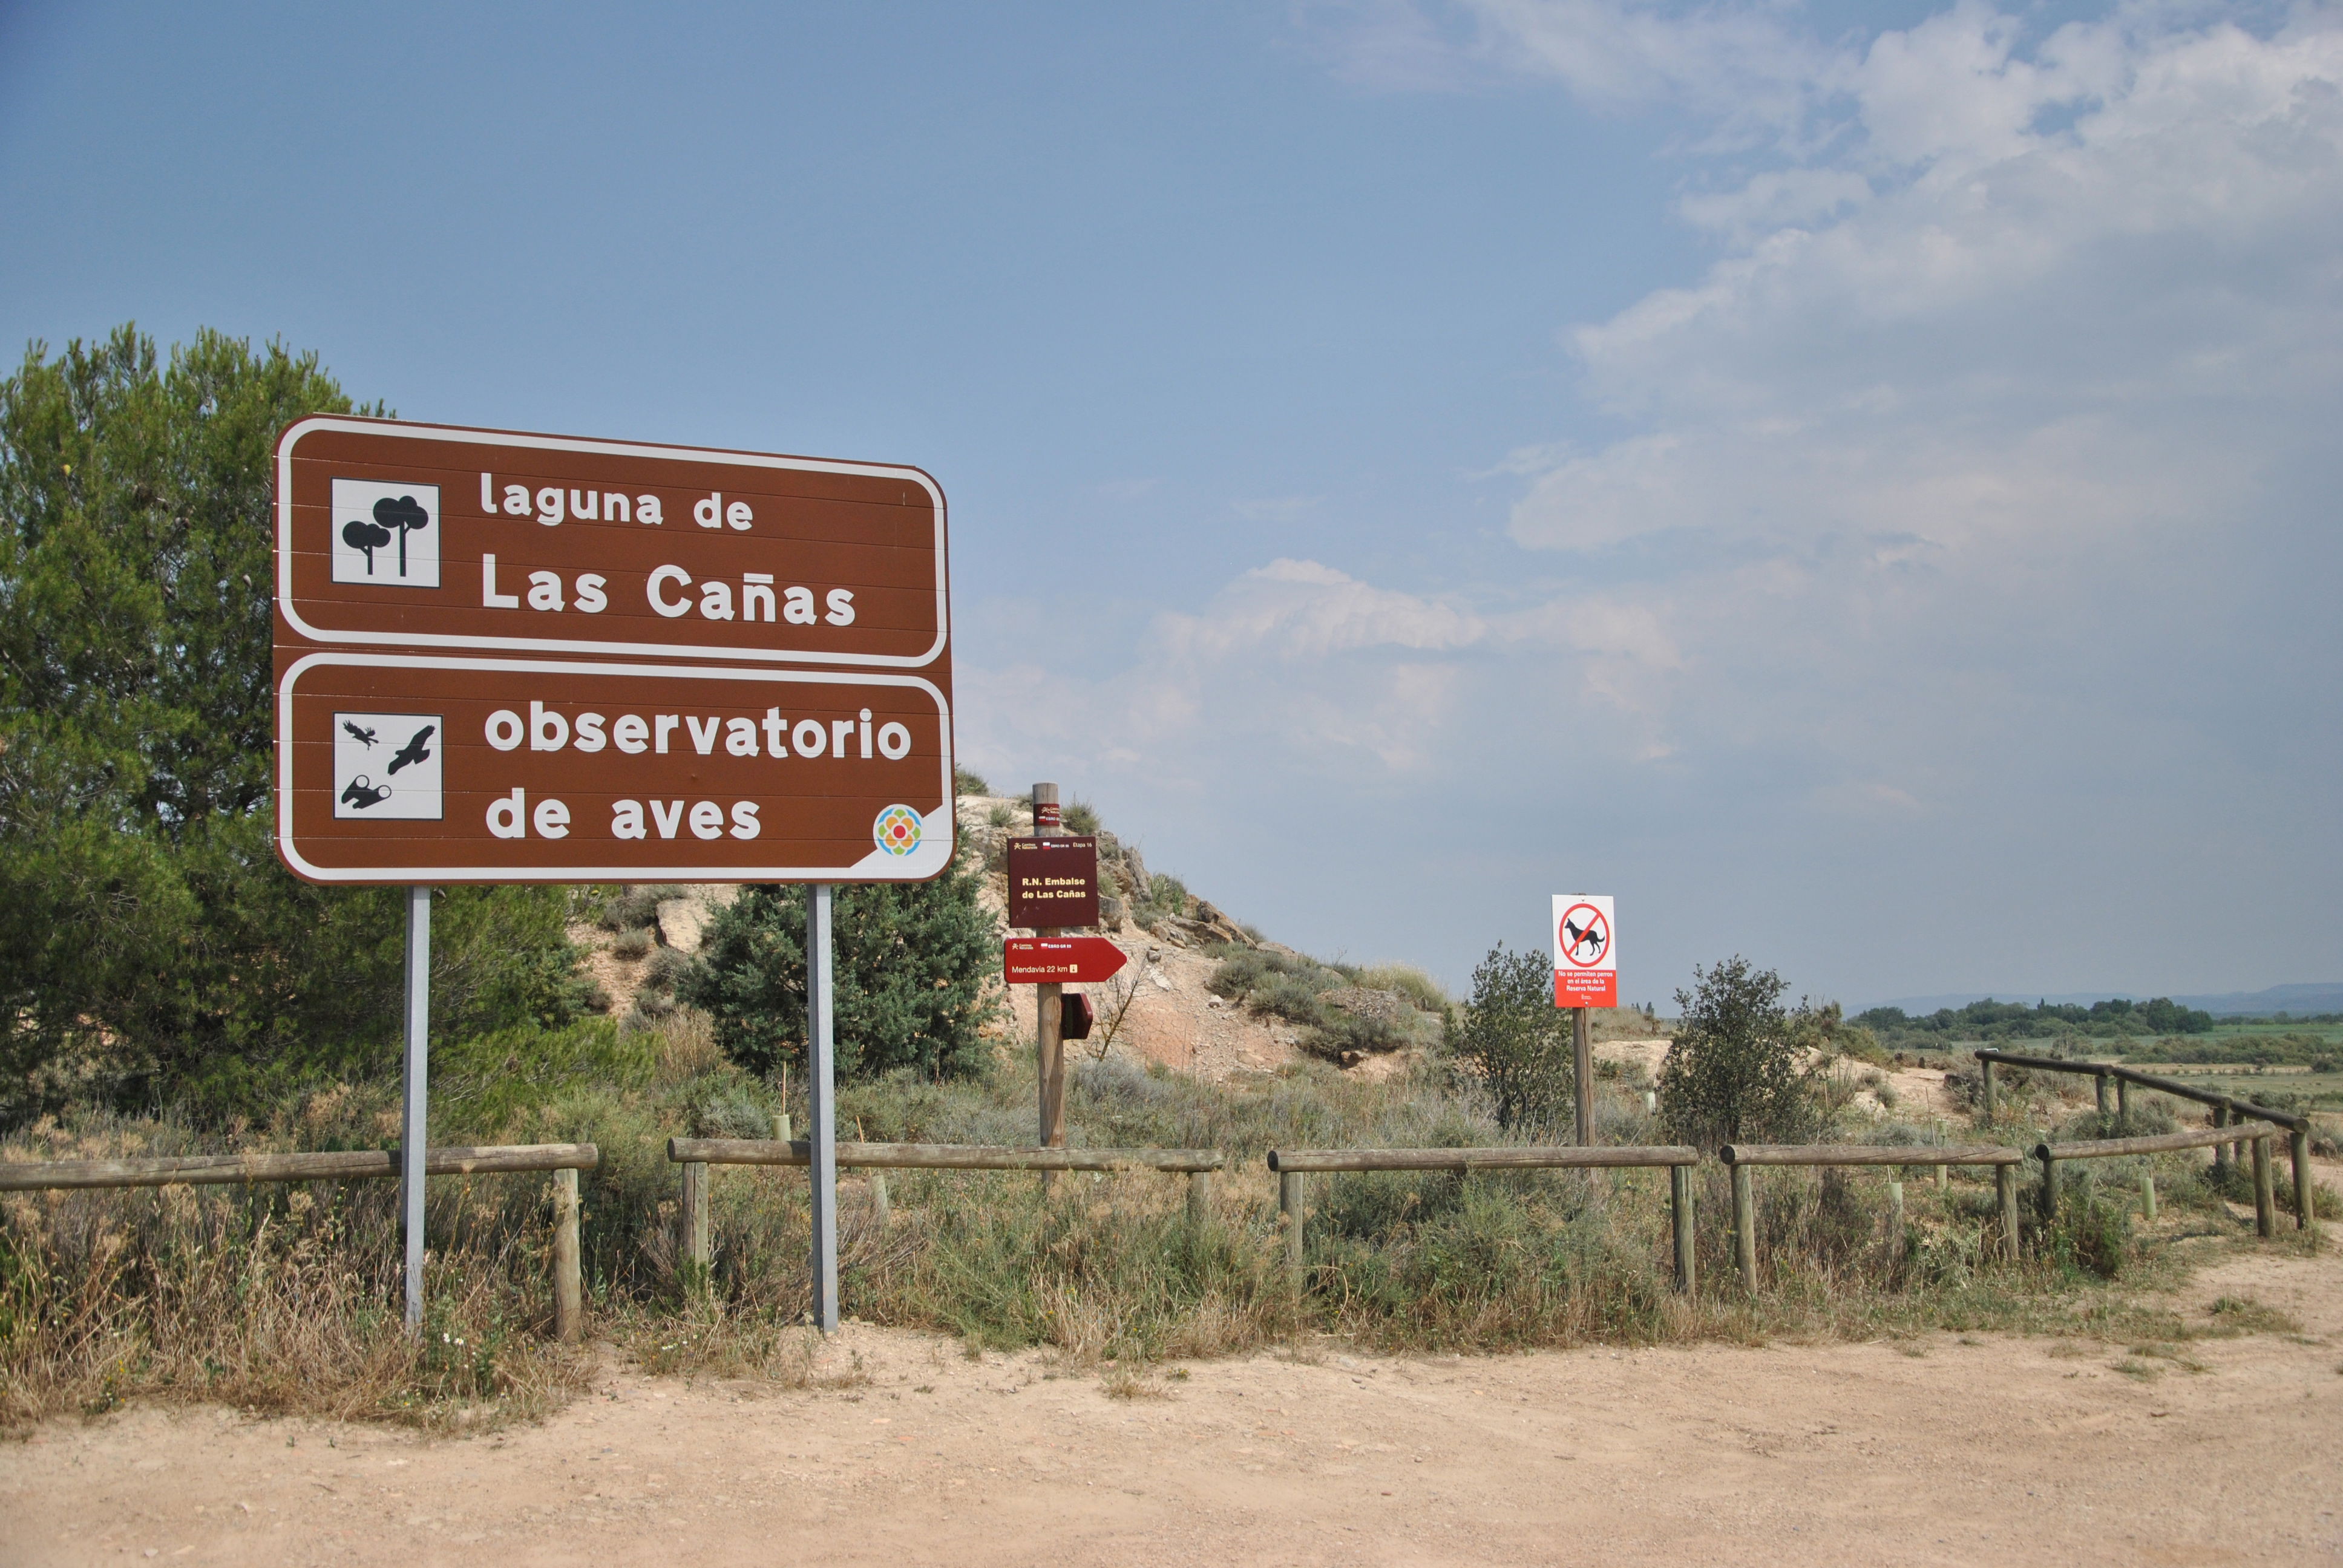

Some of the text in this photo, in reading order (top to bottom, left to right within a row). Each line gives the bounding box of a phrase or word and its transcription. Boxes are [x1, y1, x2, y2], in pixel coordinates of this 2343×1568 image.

[481, 472, 753, 531] laguna de
[482, 553, 856, 626] Las Cañas
[484, 701, 911, 760] observatorio
[485, 787, 761, 840] de aves
[1045, 877, 1086, 886] Embalse
[1057, 890, 1086, 898] Cañas
